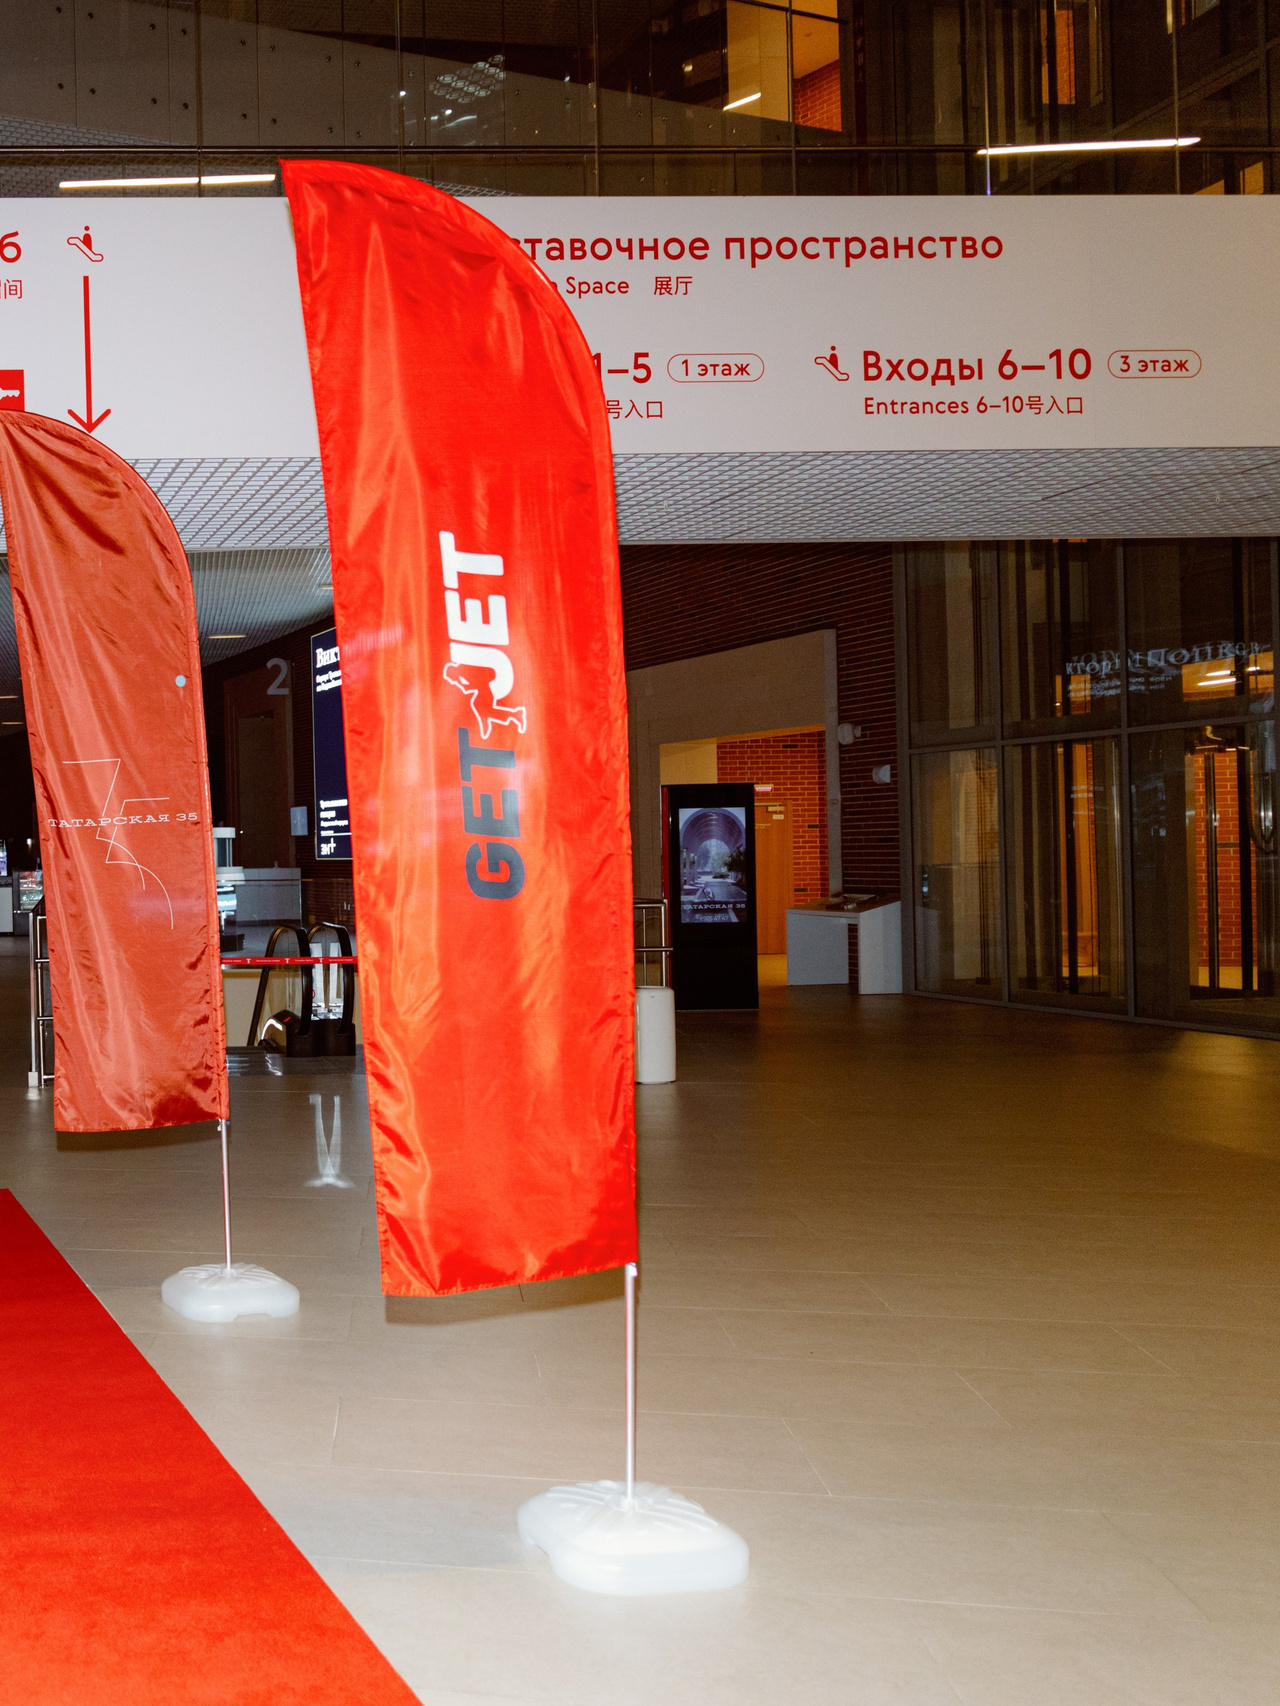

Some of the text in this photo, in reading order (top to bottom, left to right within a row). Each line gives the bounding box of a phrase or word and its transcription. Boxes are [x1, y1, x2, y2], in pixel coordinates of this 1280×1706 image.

[510, 235, 1004, 268] тавочное пространство
[565, 276, 630, 299] Space
[653, 276, 694, 296] 展厅
[681, 359, 751, 377] 1 этаж
[862, 350, 984, 386] Входы
[1119, 355, 1190, 373] 3 этаж
[864, 397, 969, 415] Entrances
[266, 657, 290, 695] 2
[48, 812, 198, 828] ТАТАРСКАЯ 35
